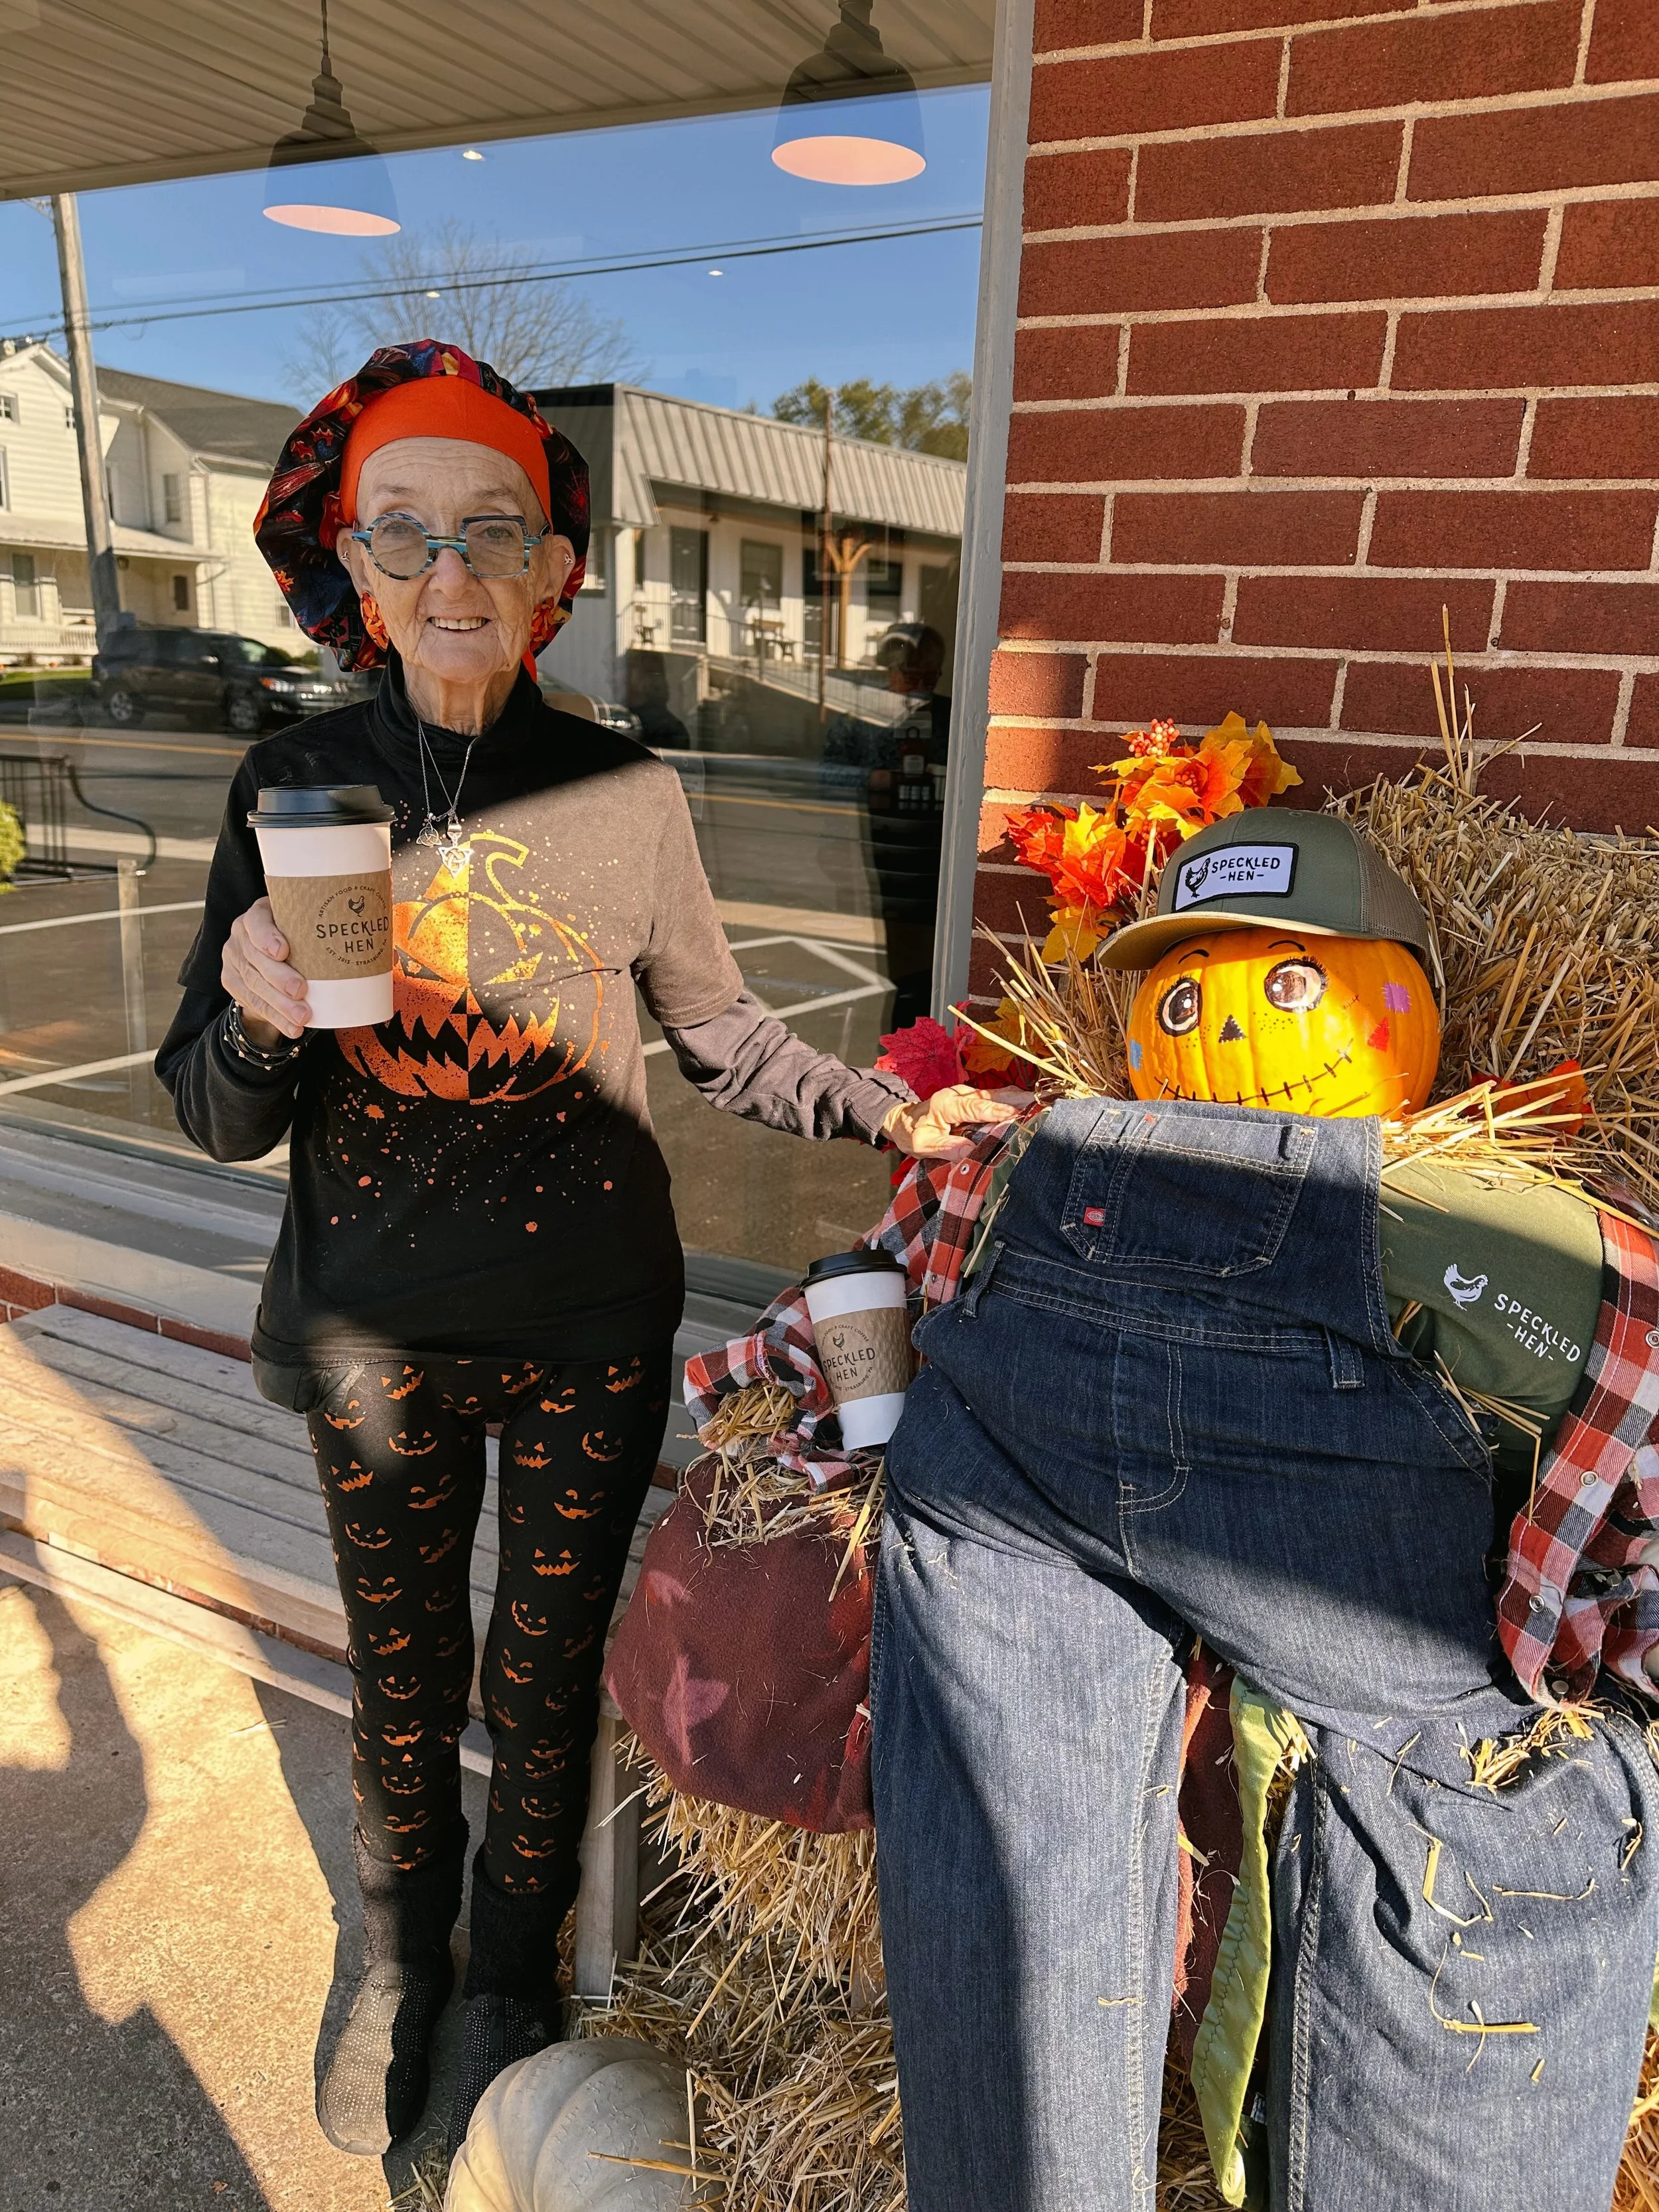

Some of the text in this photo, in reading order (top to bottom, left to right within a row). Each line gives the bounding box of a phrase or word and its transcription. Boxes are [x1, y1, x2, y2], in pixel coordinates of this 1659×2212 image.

[1211, 857, 1280, 873] SPECKLED
[319, 895, 334, 917] ARTISAN
[335, 887, 352, 897] FOOD
[316, 917, 389, 938] SPECKLED
[344, 938, 374, 953] HEN
[338, 956, 350, 964] 2015
[1494, 1293, 1581, 1362] SPECKLED
[823, 1347, 875, 1372] SPECKLED
[836, 1367, 857, 1381] HEN
